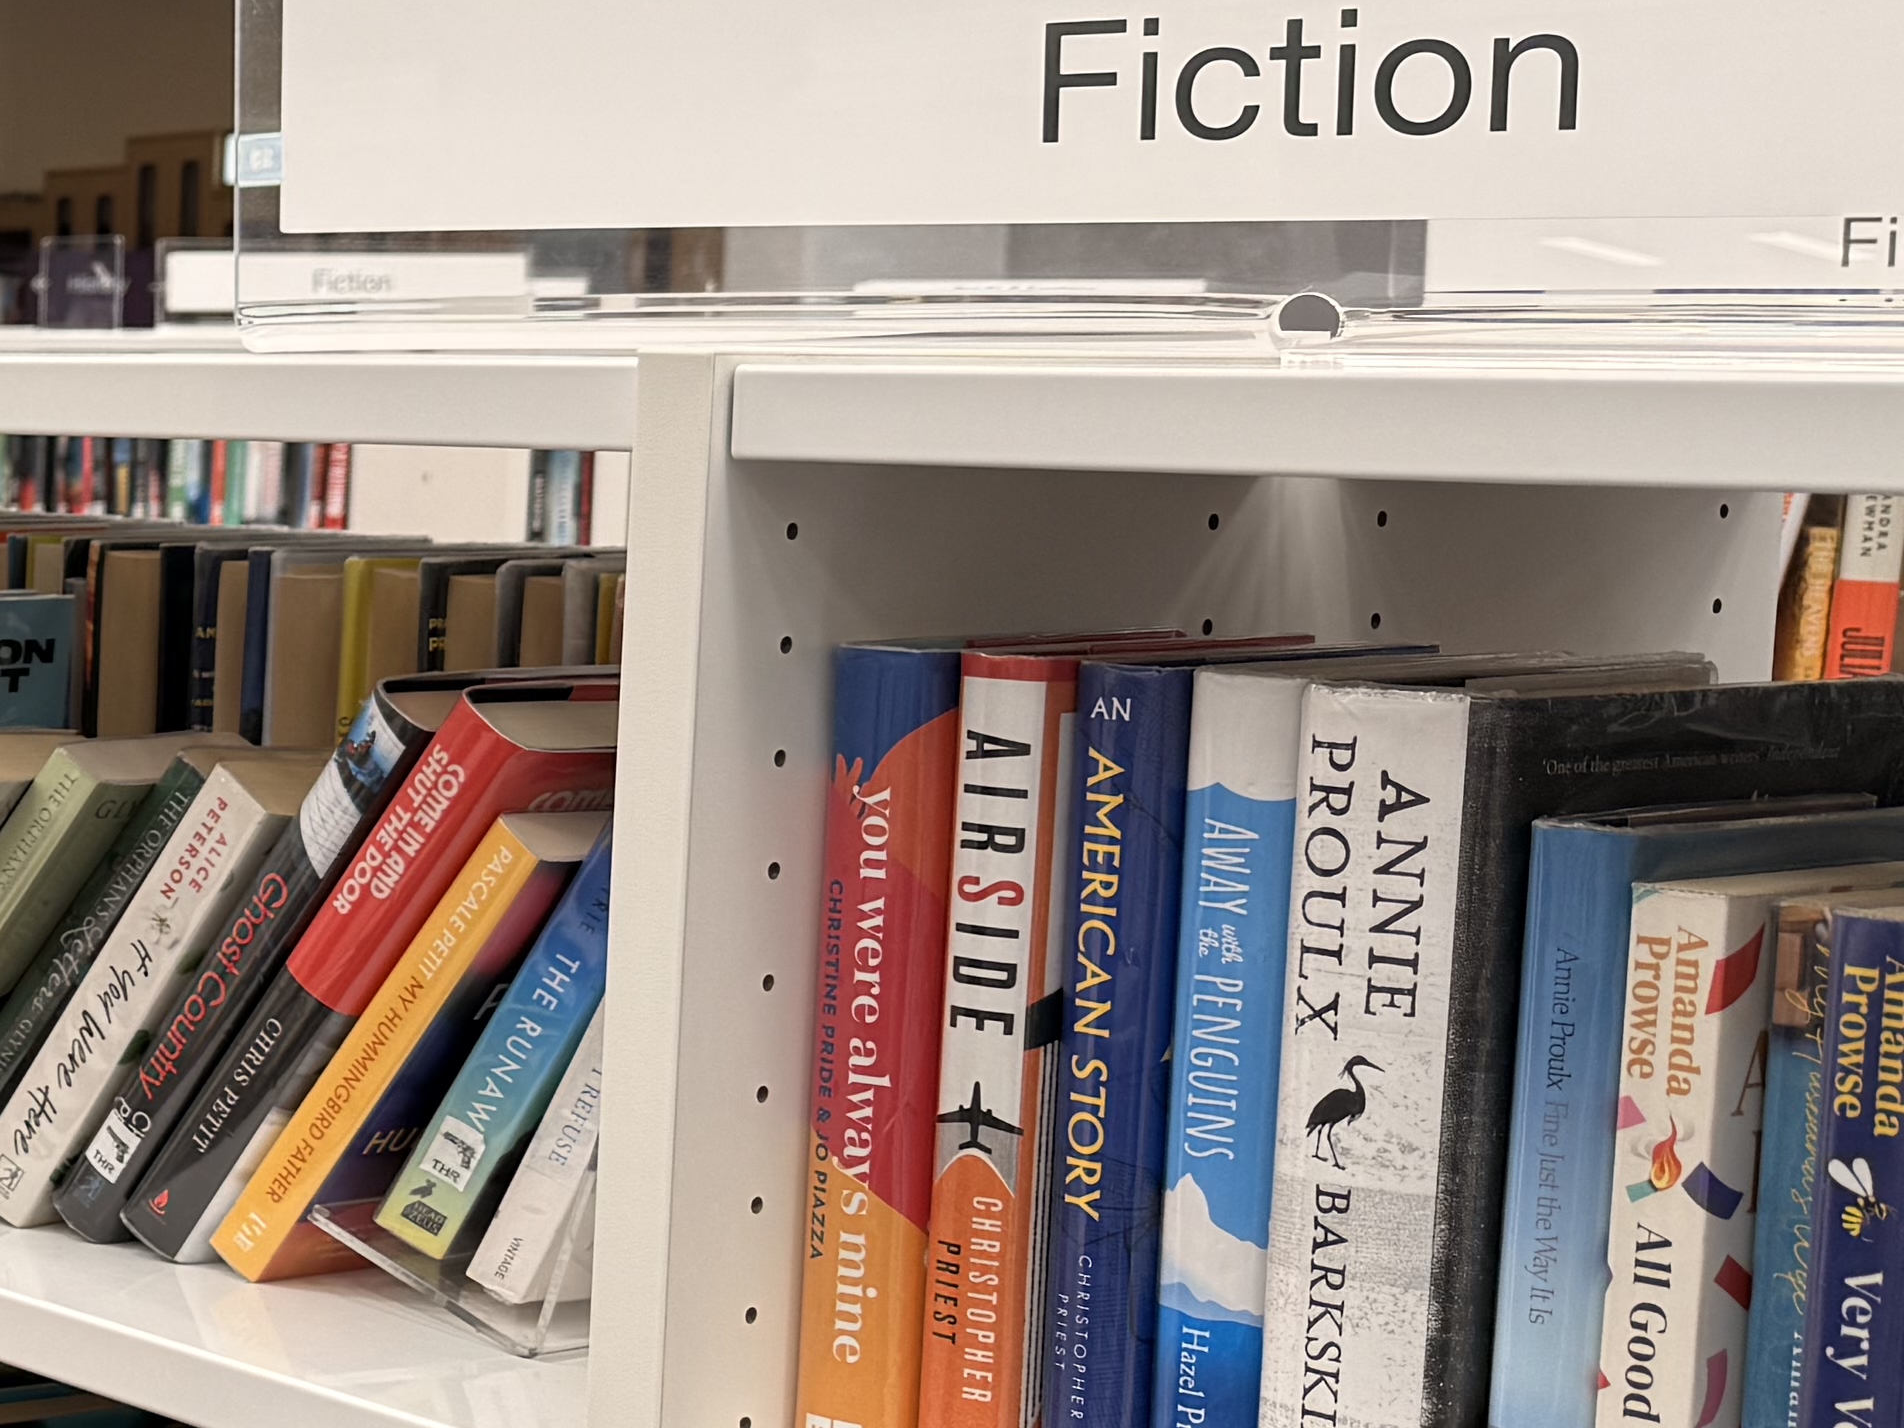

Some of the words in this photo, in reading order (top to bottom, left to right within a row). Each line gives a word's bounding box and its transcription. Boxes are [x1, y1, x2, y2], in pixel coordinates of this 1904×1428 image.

[1037, 6, 1583, 146] Fiction
[311, 268, 391, 295] Fiction
[1090, 694, 1133, 723] AN
[407, 744, 449, 808] SHUT
[413, 764, 465, 833] COME
[370, 850, 405, 900] AND
[376, 805, 412, 852] THE
[397, 826, 425, 857] IN
[852, 784, 892, 880] you
[1199, 817, 1260, 916] AWAY
[218, 873, 290, 966] Ghost
[333, 844, 383, 914] DOOR
[448, 845, 513, 934] PASCALE
[951, 729, 1031, 1036] AIRSIDE
[1073, 747, 1125, 1041] AMERICAN
[1292, 735, 1357, 1040] PROULX
[1366, 771, 1431, 1019] ANNIE
[398, 975, 425, 1014] MY
[418, 927, 457, 980] PETIT
[850, 902, 886, 1025] were
[141, 957, 229, 1101] Country
[233, 1018, 282, 1087] CHRIS
[1628, 932, 1673, 1082] Prowse
[1665, 923, 1709, 1096] Amanda
[302, 1006, 404, 1141] HUMMINGBIRD
[1184, 976, 1245, 1163] PENGUINS
[192, 1086, 240, 1153] PETIT
[831, 1039, 892, 1216] always
[1061, 1054, 1110, 1221] STORY
[266, 1138, 315, 1204] FATHER
[832, 1227, 877, 1365] mine
[933, 1238, 962, 1345] PRIEST
[961, 1195, 1005, 1404] CHRISTOPHER
[1635, 1223, 1674, 1285] All
[1179, 1326, 1210, 1398] Hazel
[1622, 1298, 1673, 1423] Good
